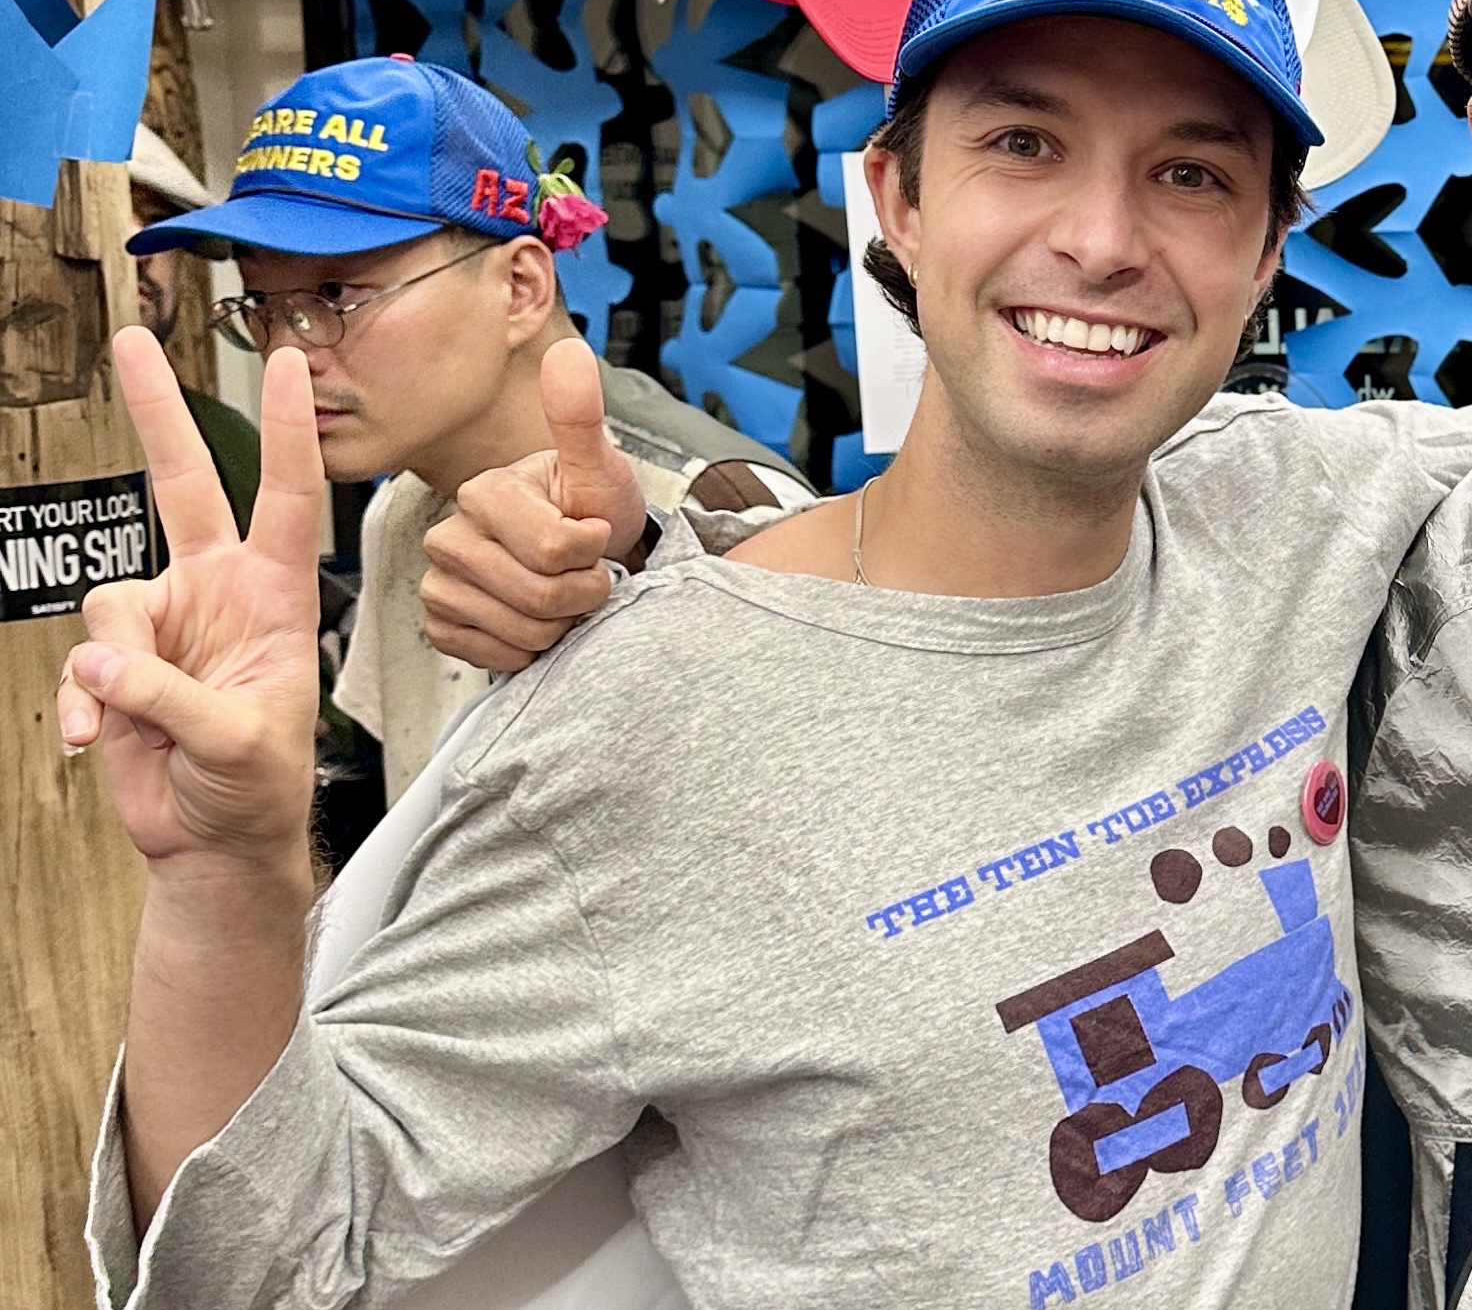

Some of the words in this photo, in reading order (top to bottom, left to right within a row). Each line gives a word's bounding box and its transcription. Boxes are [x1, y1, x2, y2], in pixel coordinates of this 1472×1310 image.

[261, 108, 319, 136] ARE
[318, 113, 389, 152] ALL
[470, 167, 531, 225] AZ
[29, 499, 94, 530] YOUR
[84, 522, 147, 582] SHOP
[865, 875, 976, 939] THE
[977, 830, 1082, 893] TEN
[1087, 789, 1178, 845] TOE
[1175, 704, 1328, 810] EXPRESS
[1223, 1116, 1321, 1219] FEET
